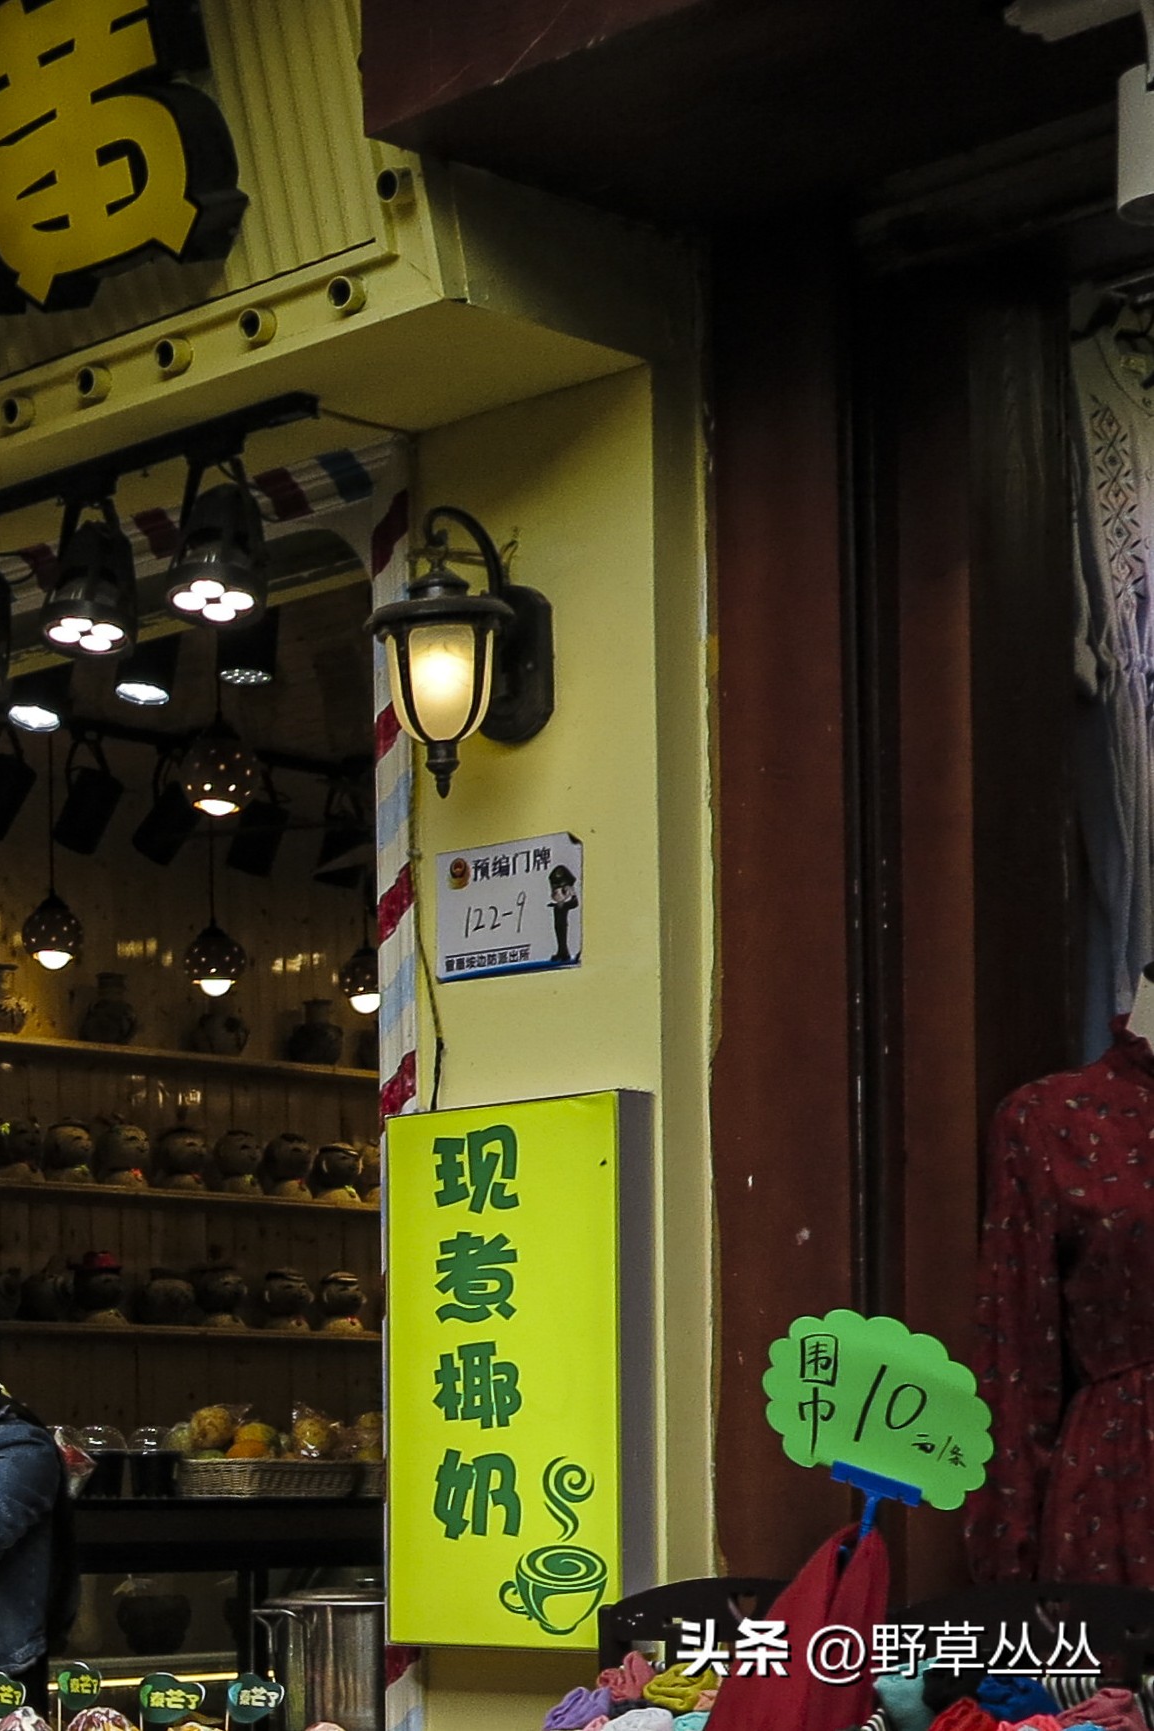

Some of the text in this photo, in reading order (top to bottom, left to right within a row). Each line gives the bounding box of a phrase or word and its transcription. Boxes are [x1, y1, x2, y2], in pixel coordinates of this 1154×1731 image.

[472, 847, 552, 882] 预编门牌
[464, 891, 527, 939] 122-9
[432, 1124, 523, 1541] 现煮椰奶
[798, 1333, 839, 1456] 围巾
